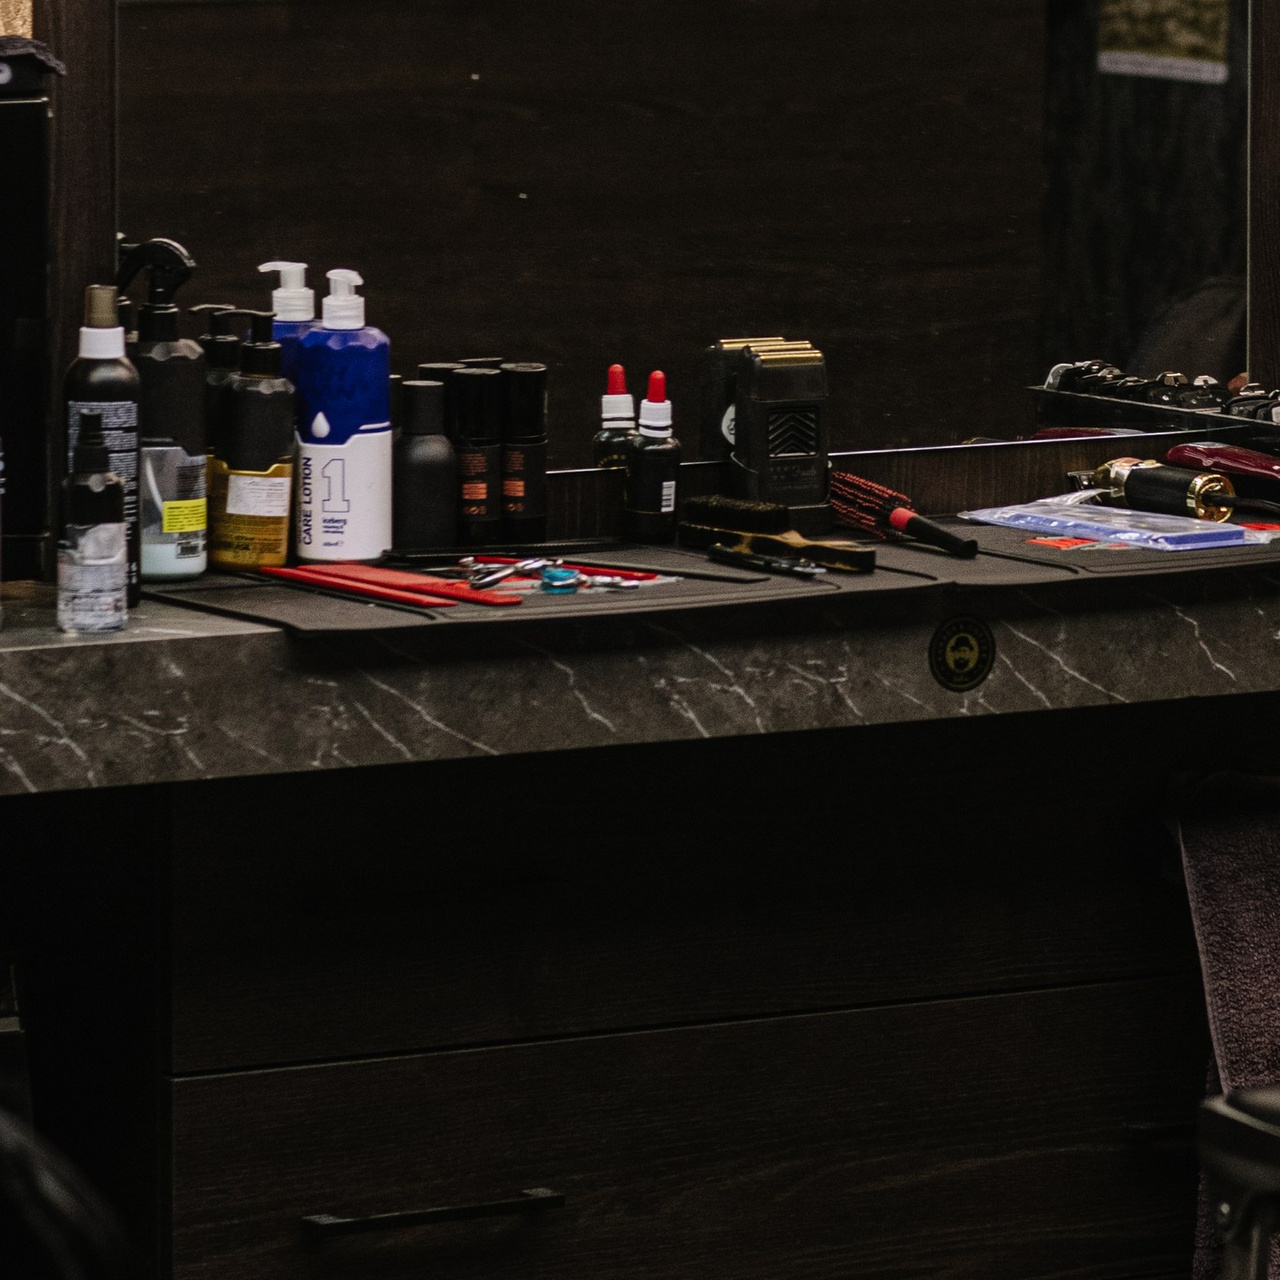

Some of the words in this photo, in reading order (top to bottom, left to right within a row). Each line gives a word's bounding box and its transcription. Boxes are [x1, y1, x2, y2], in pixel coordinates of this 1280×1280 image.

[302, 456, 313, 505] LOTION
[321, 458, 350, 513] 1
[302, 510, 313, 545] CARE
